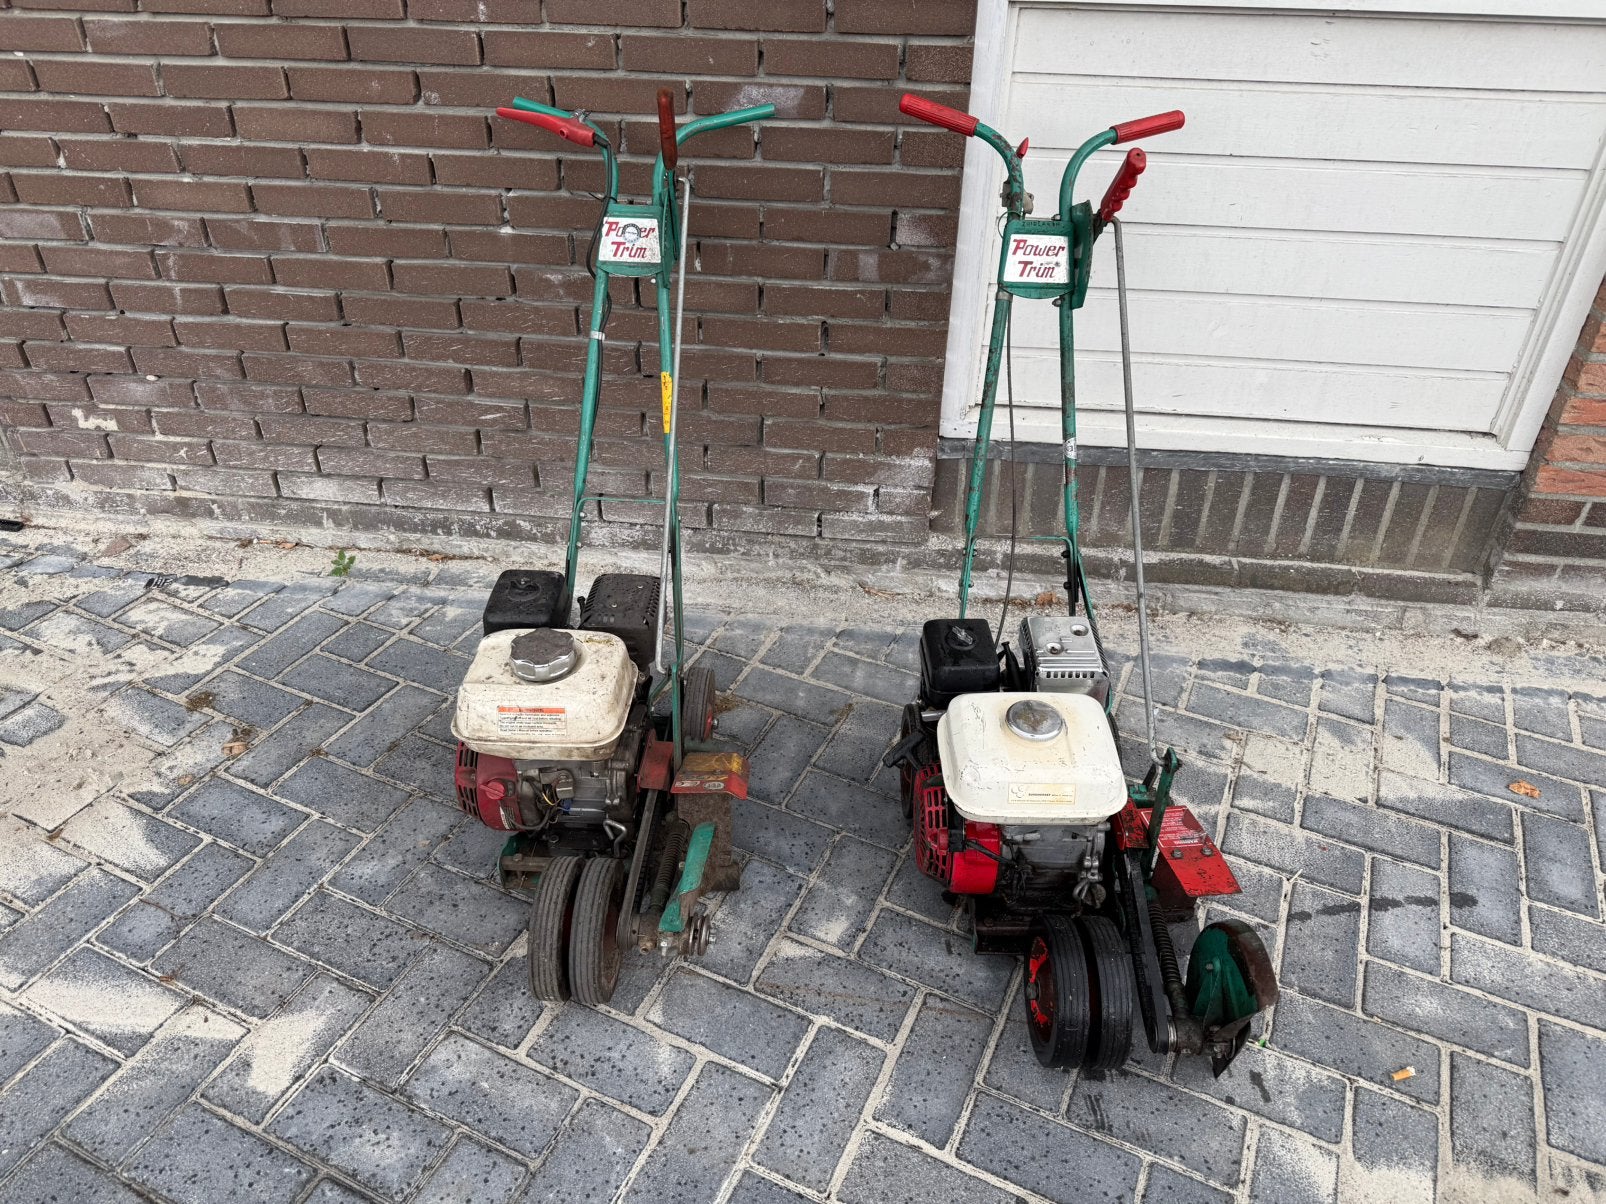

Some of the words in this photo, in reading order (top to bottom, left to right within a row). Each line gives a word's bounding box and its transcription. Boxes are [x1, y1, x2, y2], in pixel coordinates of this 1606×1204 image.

[605, 222, 656, 238] Poer
[611, 241, 647, 258] Trim
[1012, 239, 1065, 257] Power
[1018, 261, 1056, 278] Trim
